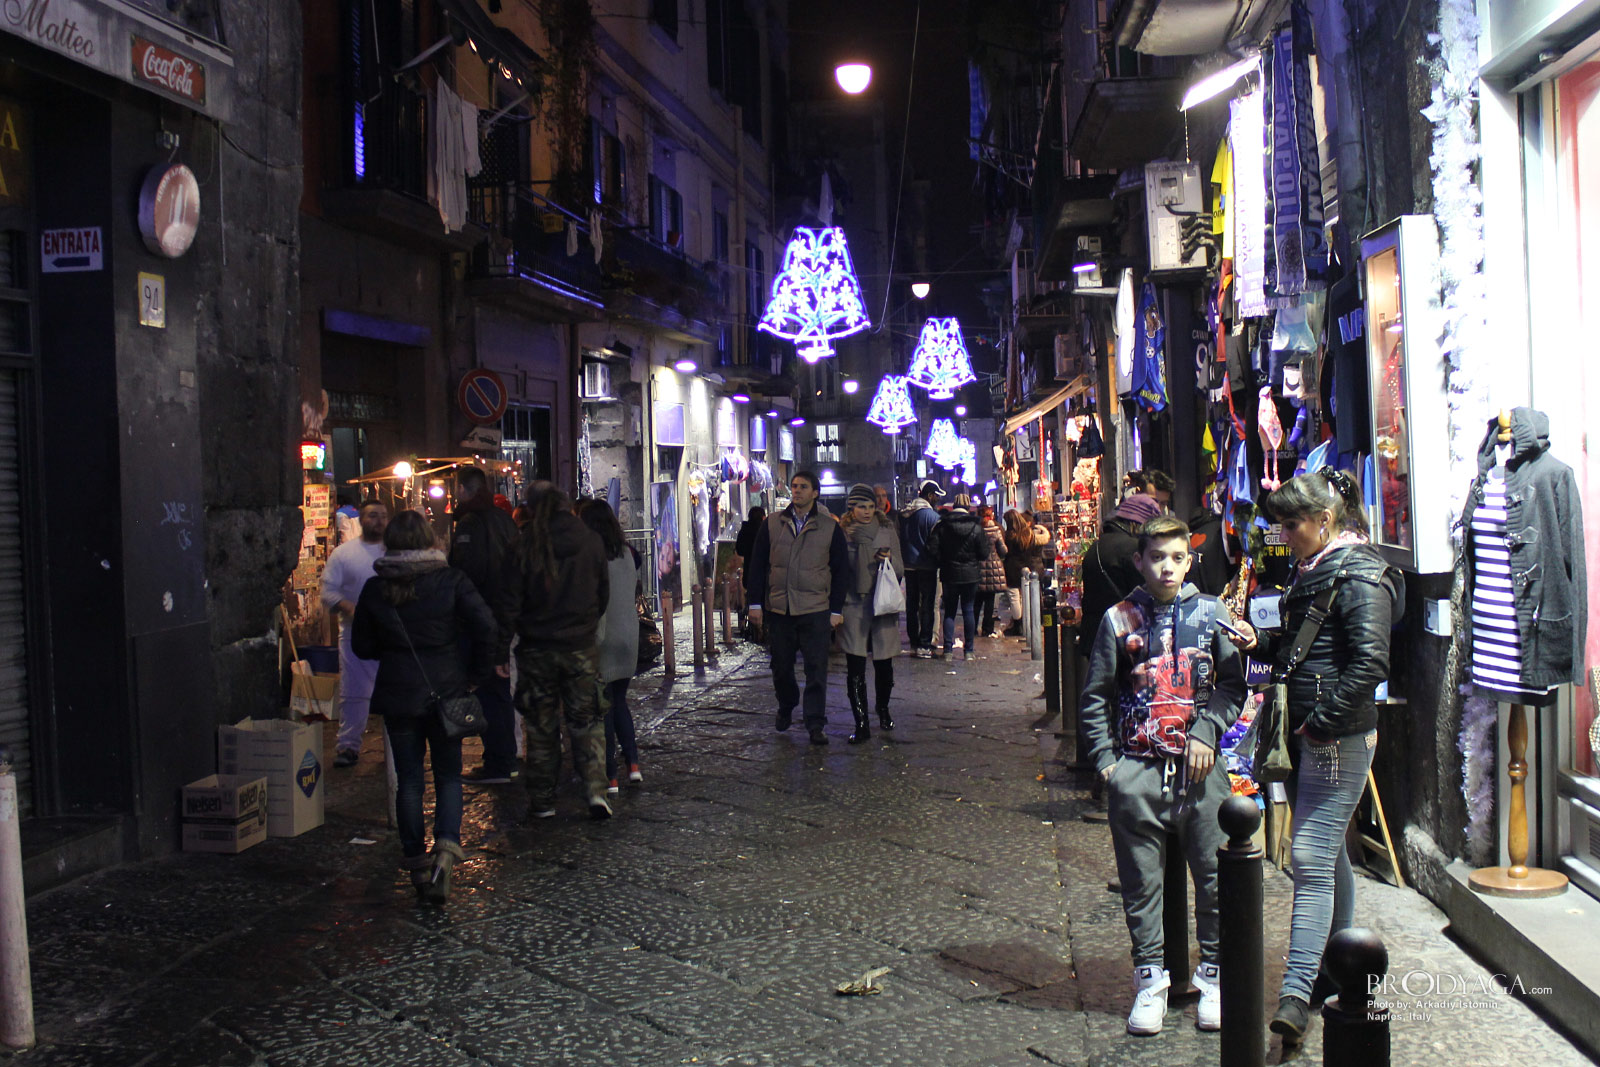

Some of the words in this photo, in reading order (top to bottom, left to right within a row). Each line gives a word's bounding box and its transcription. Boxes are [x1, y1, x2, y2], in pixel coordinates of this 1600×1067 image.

[3, 0, 94, 57] Matteo
[1275, 102, 1298, 224] NAPOLI
[44, 231, 99, 255] ENTRATA
[144, 285, 159, 313] 94
[1171, 671, 1185, 688] 83
[187, 796, 221, 814] Nelsen
